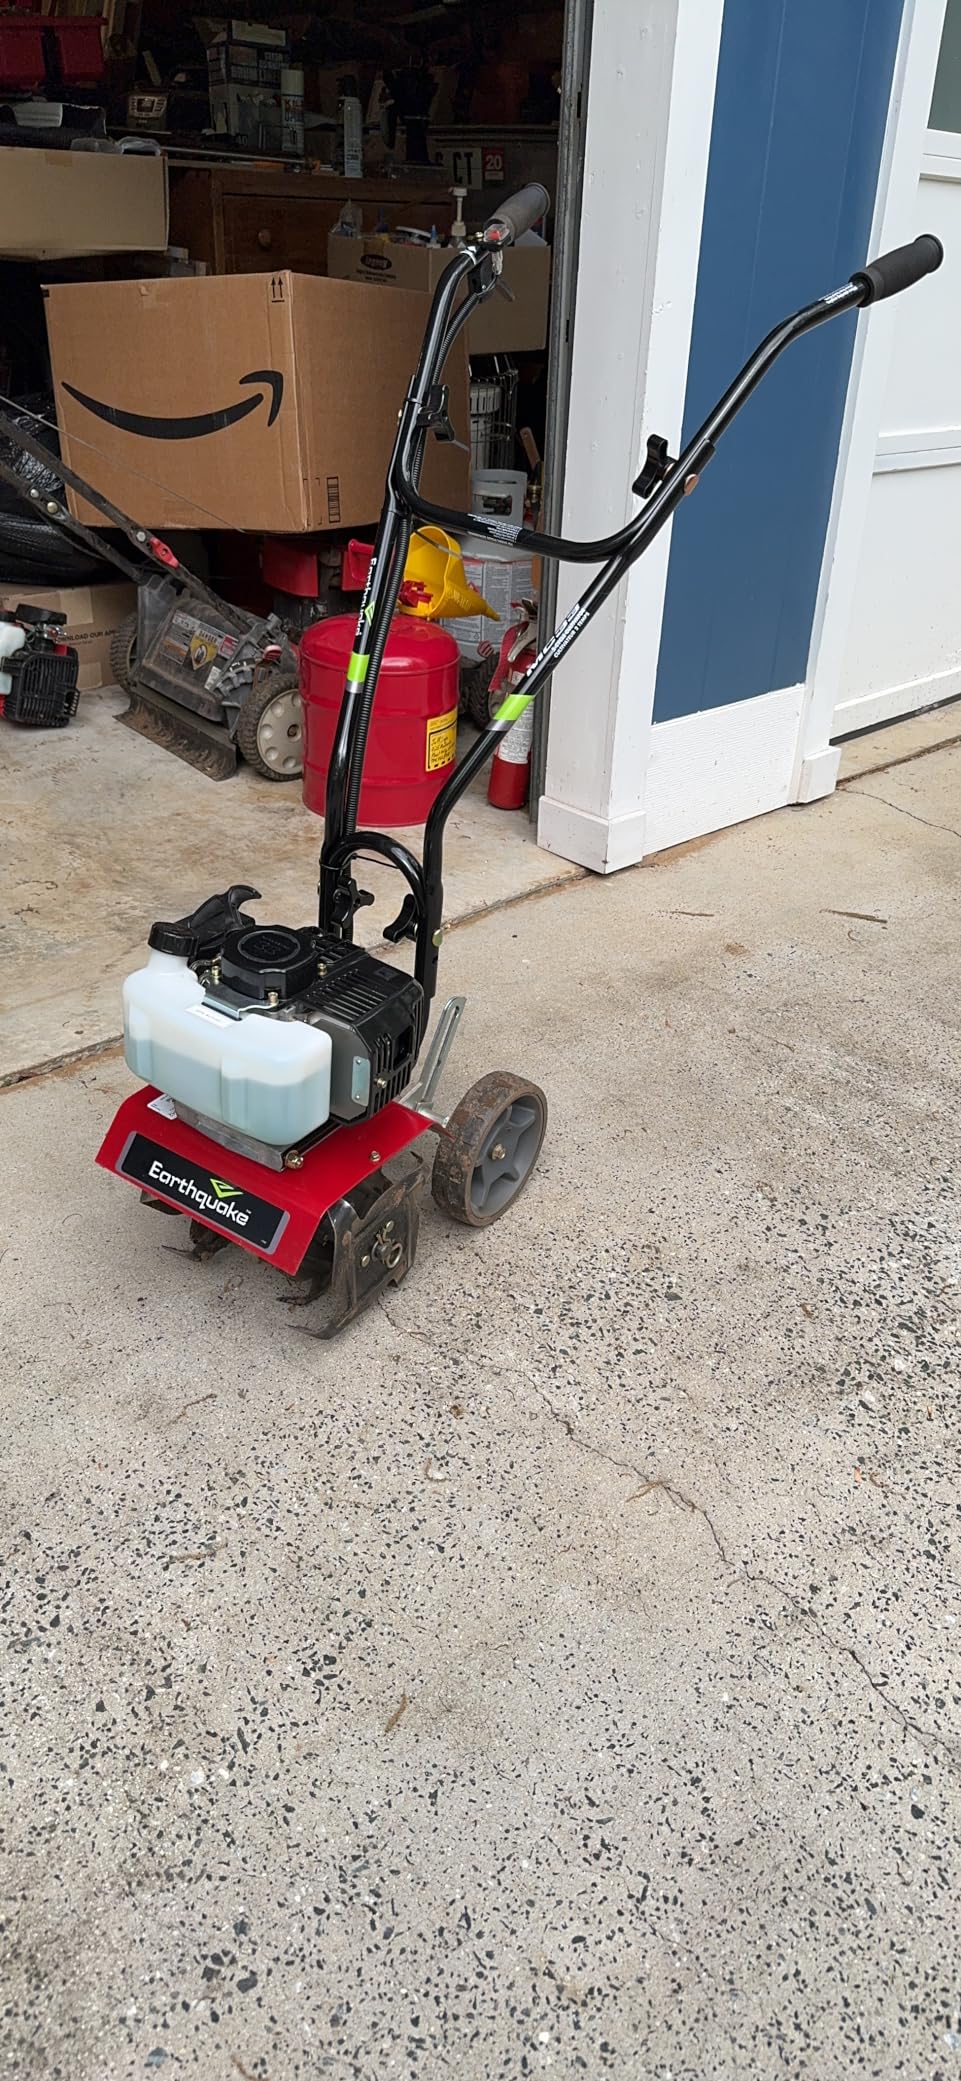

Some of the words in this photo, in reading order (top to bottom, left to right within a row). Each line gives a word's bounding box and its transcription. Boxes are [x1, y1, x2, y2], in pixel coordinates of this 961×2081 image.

[485, 154, 502, 170] 20
[553, 630, 577, 658] CULTIVATEUR
[577, 611, 590, 627] TEMPS
[148, 1160, 249, 1226] Earthquake
